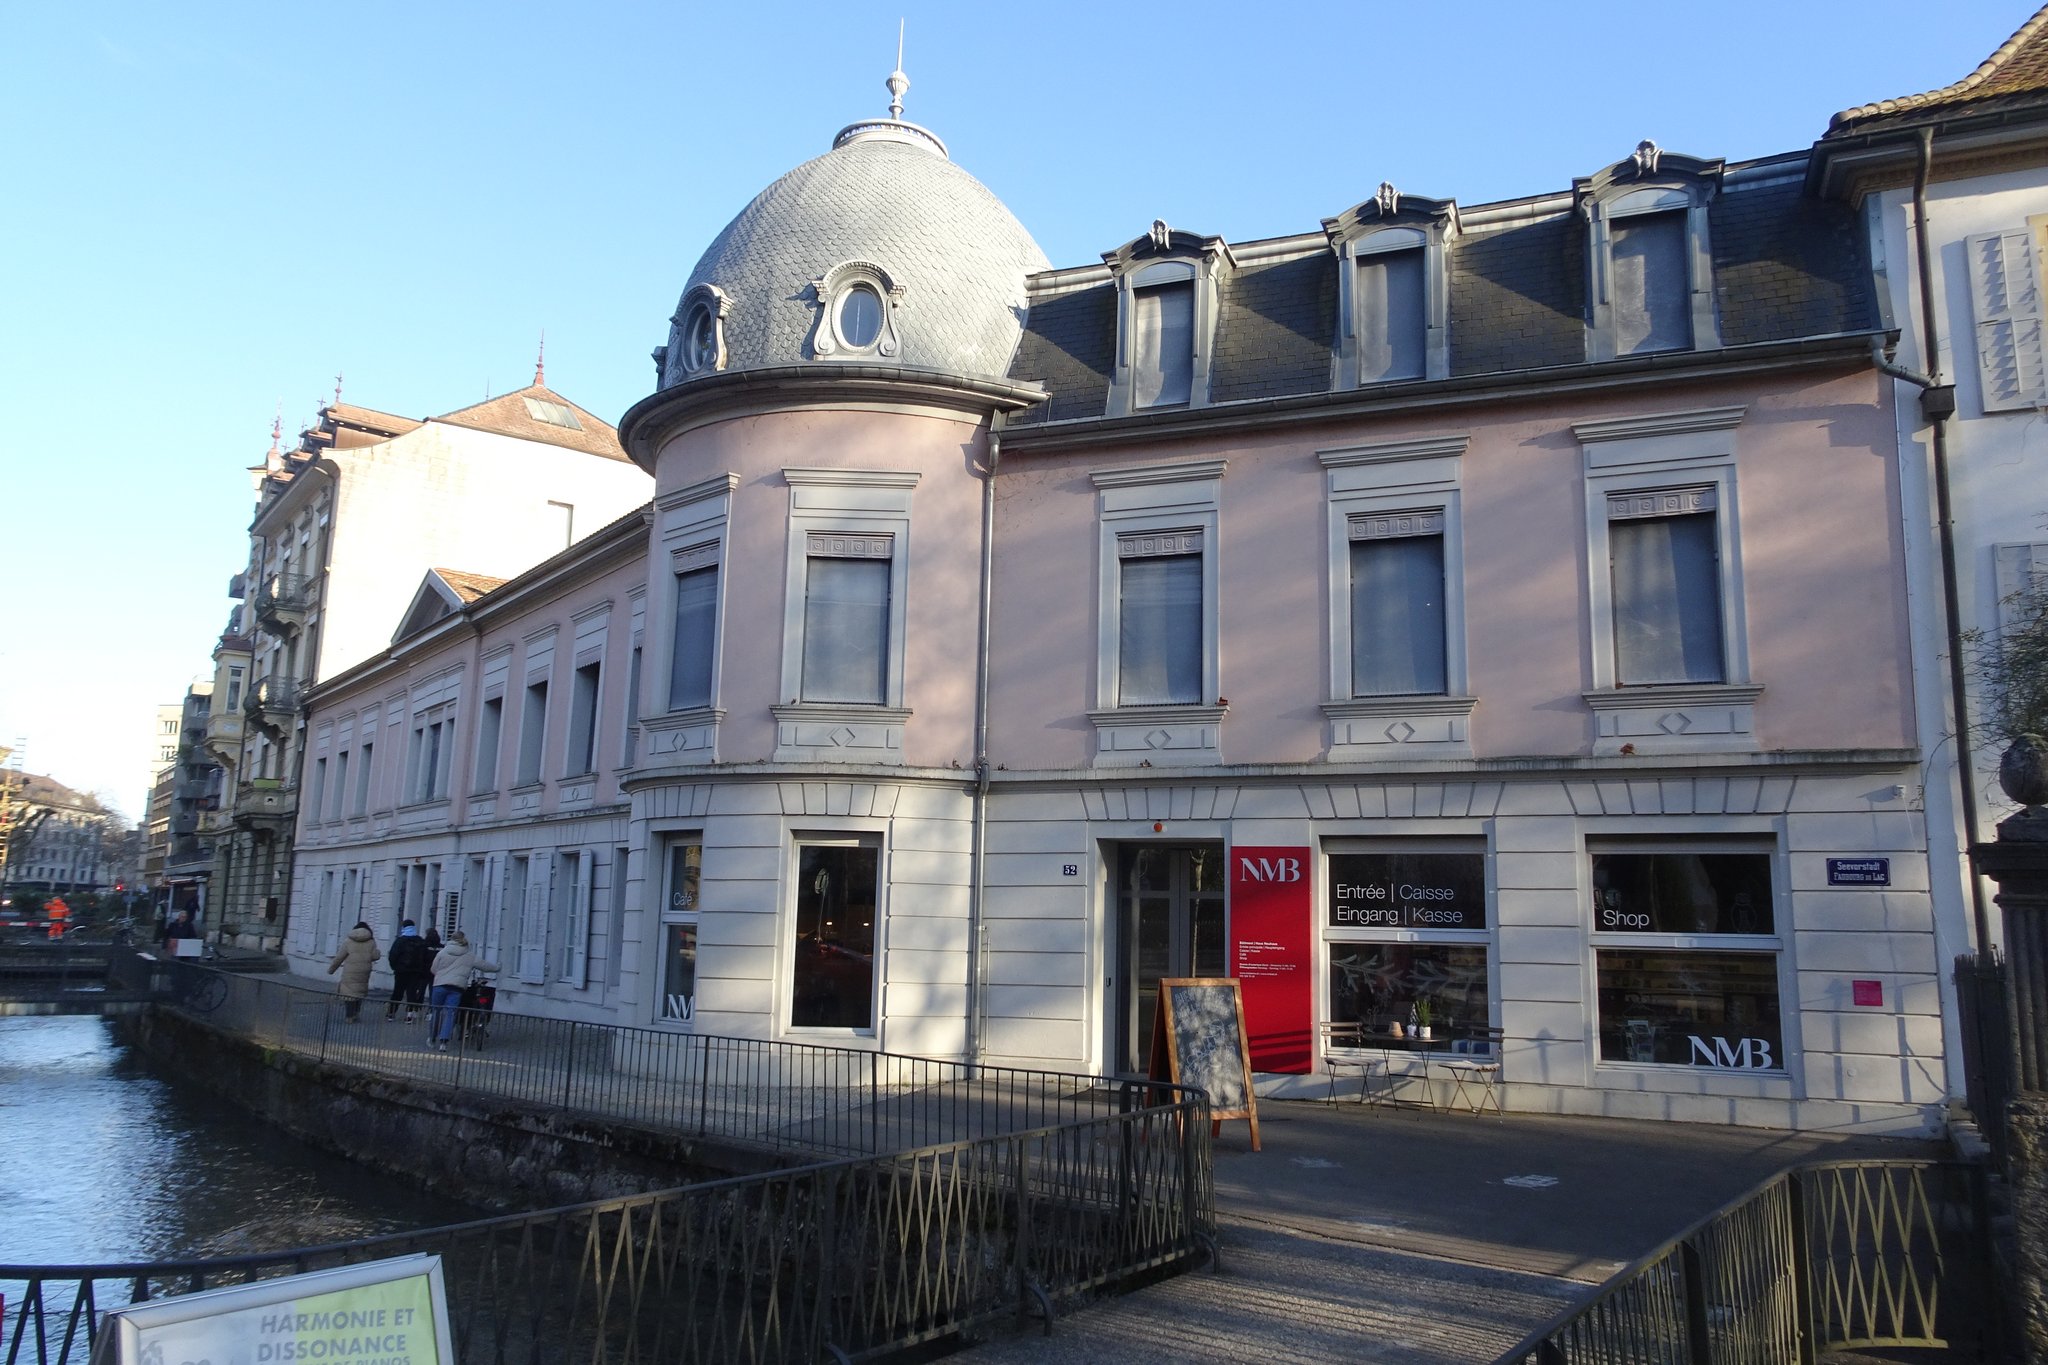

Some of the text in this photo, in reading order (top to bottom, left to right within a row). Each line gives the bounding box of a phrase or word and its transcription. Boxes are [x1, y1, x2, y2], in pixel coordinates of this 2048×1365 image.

[1064, 865, 1076, 875] 52
[1240, 857, 1300, 882] NMB
[1836, 861, 1880, 871] Seevorstadt
[1336, 883, 1454, 900] Entrée Caisse
[1337, 905, 1463, 925] Eingang Kasse
[1603, 909, 1650, 929] Shop
[1687, 1035, 1773, 1069] NMB
[260, 1308, 416, 1334] HARMONIE ET
[257, 1334, 407, 1362] DISSONANCE
